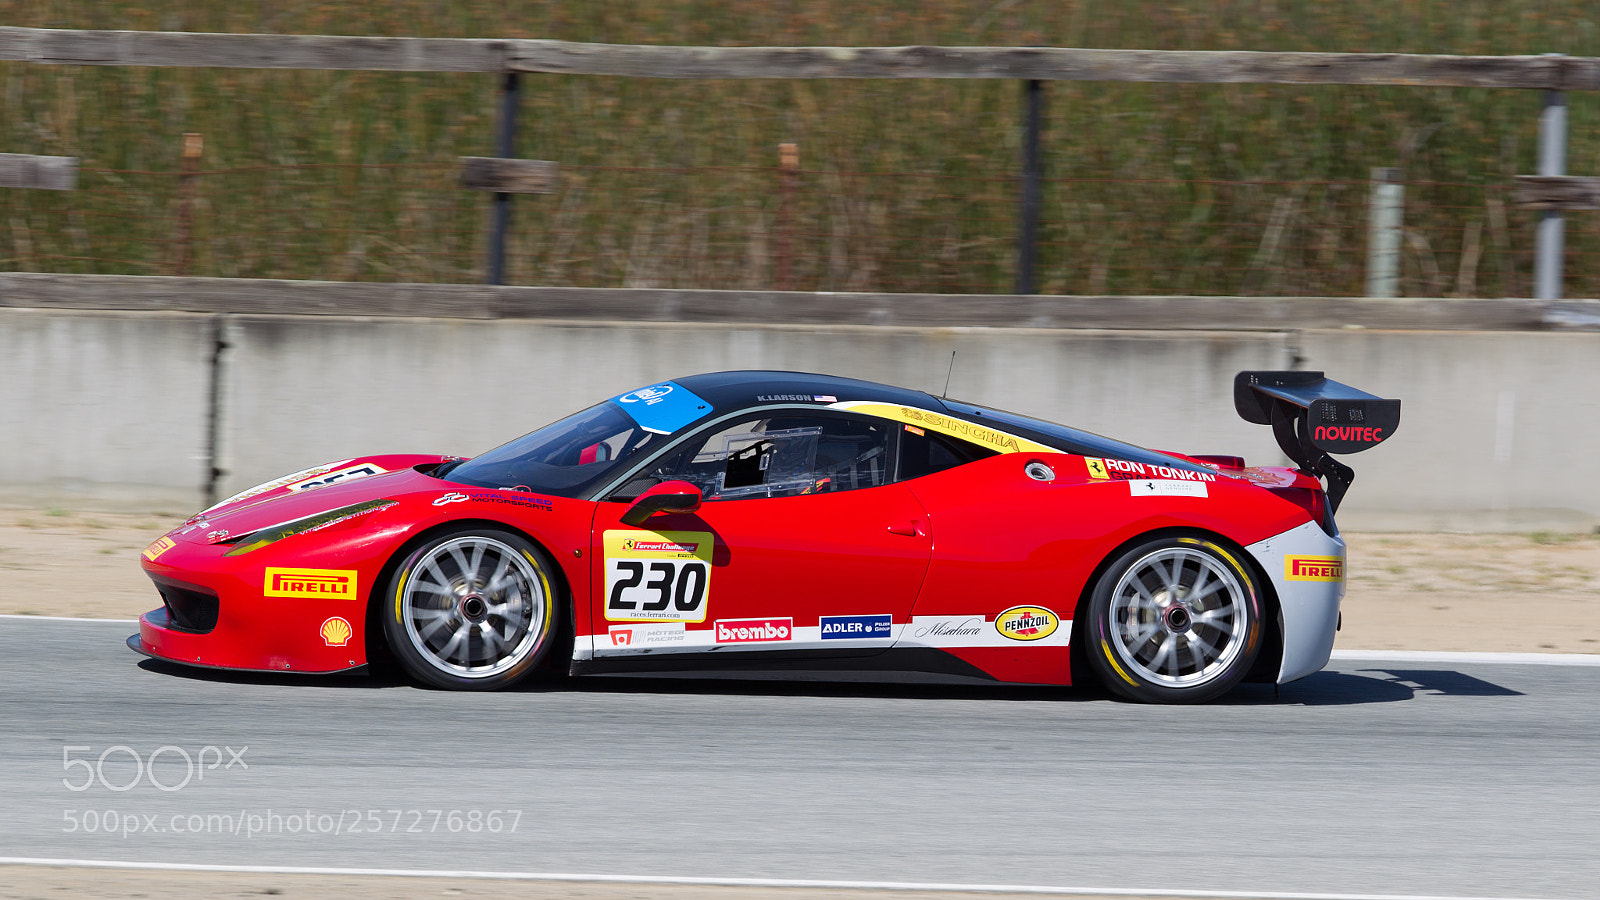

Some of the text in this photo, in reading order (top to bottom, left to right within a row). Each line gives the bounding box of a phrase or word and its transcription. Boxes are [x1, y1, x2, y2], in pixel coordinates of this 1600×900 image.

[922, 413, 1021, 453] SINGHA
[1314, 425, 1382, 442] NOVITEC
[1105, 458, 1145, 475] RON
[1147, 464, 1216, 482] TONKIN
[472, 498, 553, 511] MOTORSPORTS
[511, 495, 552, 505] SPEED
[271, 573, 349, 594] PIRELLI
[608, 561, 706, 611] 230
[718, 623, 789, 641] brembo
[822, 623, 863, 634] ADLER
[1005, 615, 1050, 632] PENNZOIL
